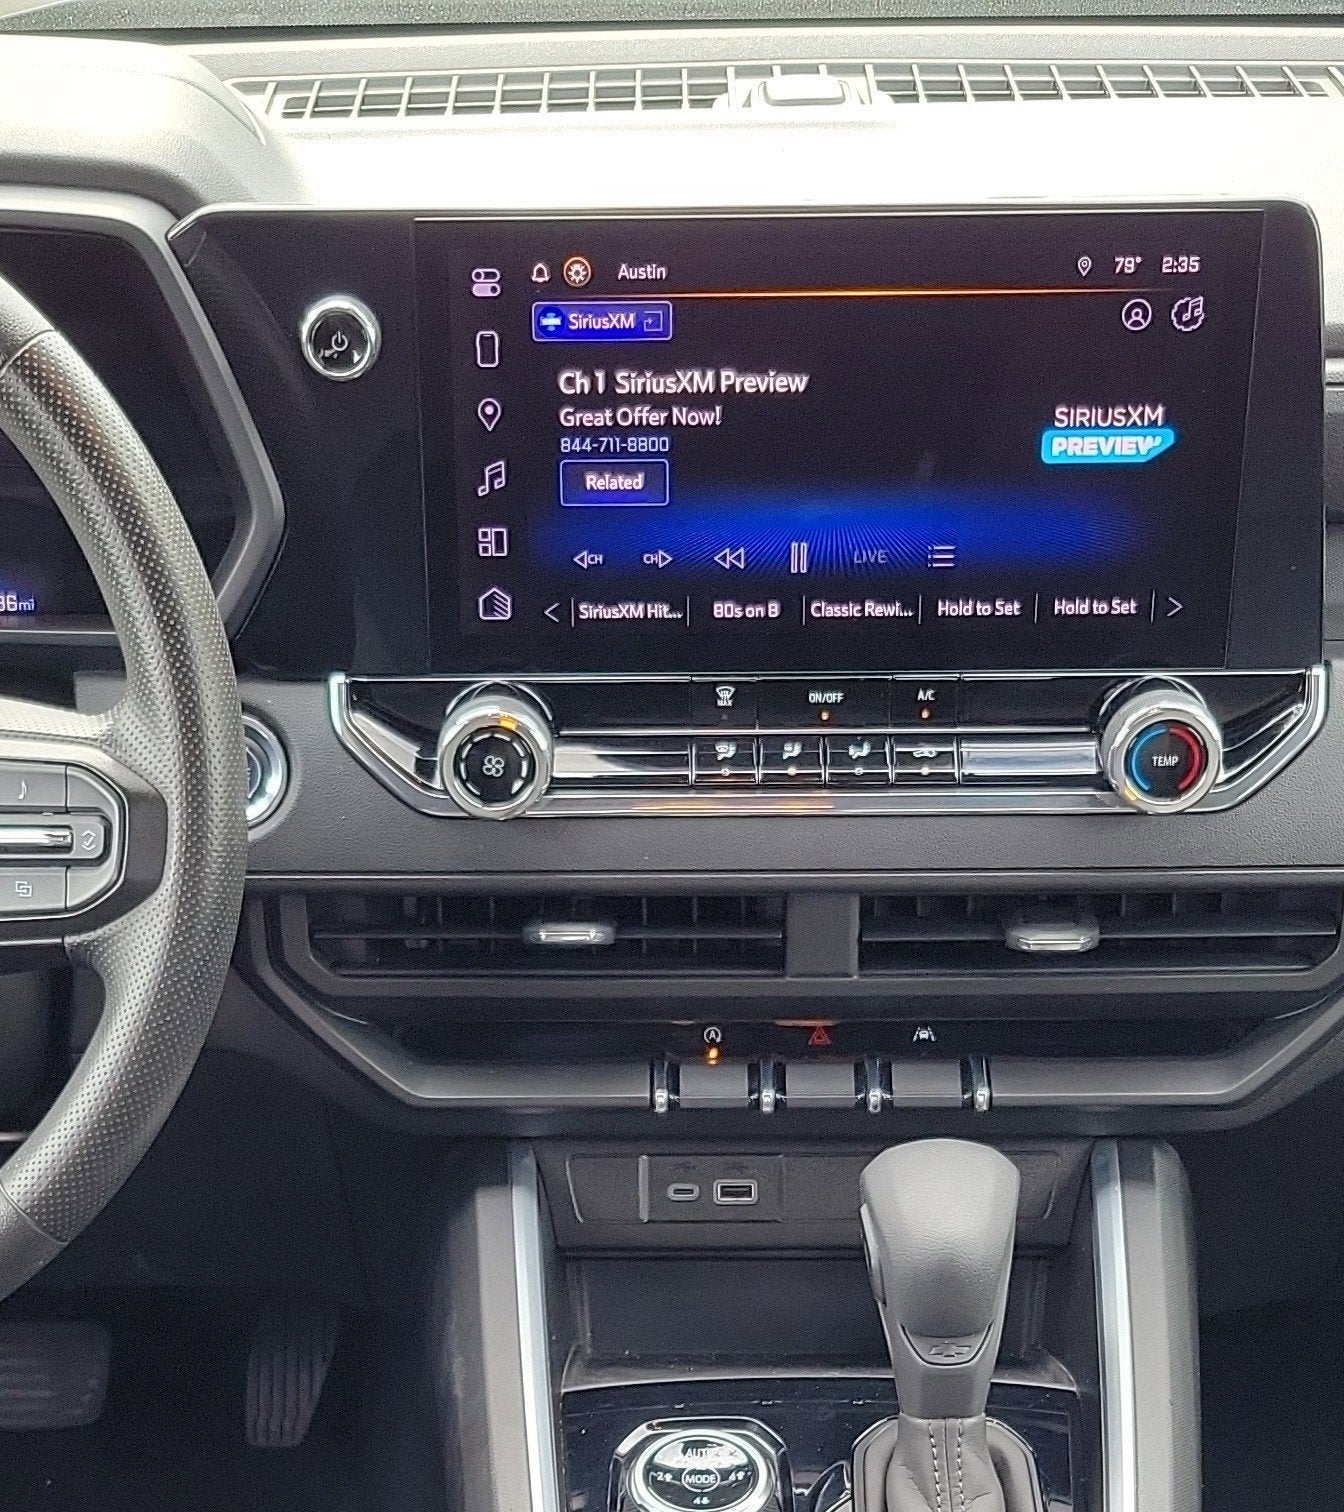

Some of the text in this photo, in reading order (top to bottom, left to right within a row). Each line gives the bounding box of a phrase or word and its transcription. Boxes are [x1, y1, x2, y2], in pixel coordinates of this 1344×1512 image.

[618, 263, 667, 281] Austin
[1114, 256, 1142, 274] 79°
[1161, 256, 1201, 273] 2:35
[568, 313, 636, 330] SiriusXM
[558, 369, 809, 394] Ch 1 SiriusXM Preview
[559, 405, 723, 427] Great Offer Now!
[1054, 405, 1164, 428] SIRIUSXM
[560, 436, 669, 453] 844-711-8800
[1051, 435, 1163, 457] PREVIEW
[585, 472, 645, 491] Related
[854, 549, 889, 565] LIVE
[578, 602, 644, 619] SiriusXM
[713, 602, 743, 619] 80s
[745, 606, 765, 619] on
[810, 601, 862, 618] Classic
[937, 598, 1022, 617] Hold to Set
[1054, 597, 1138, 616] Hold to Set
[808, 692, 844, 704] ON/OFF
[917, 689, 936, 701] A/C
[1152, 755, 1179, 767] TEMP
[686, 1474, 716, 1484] MODE
